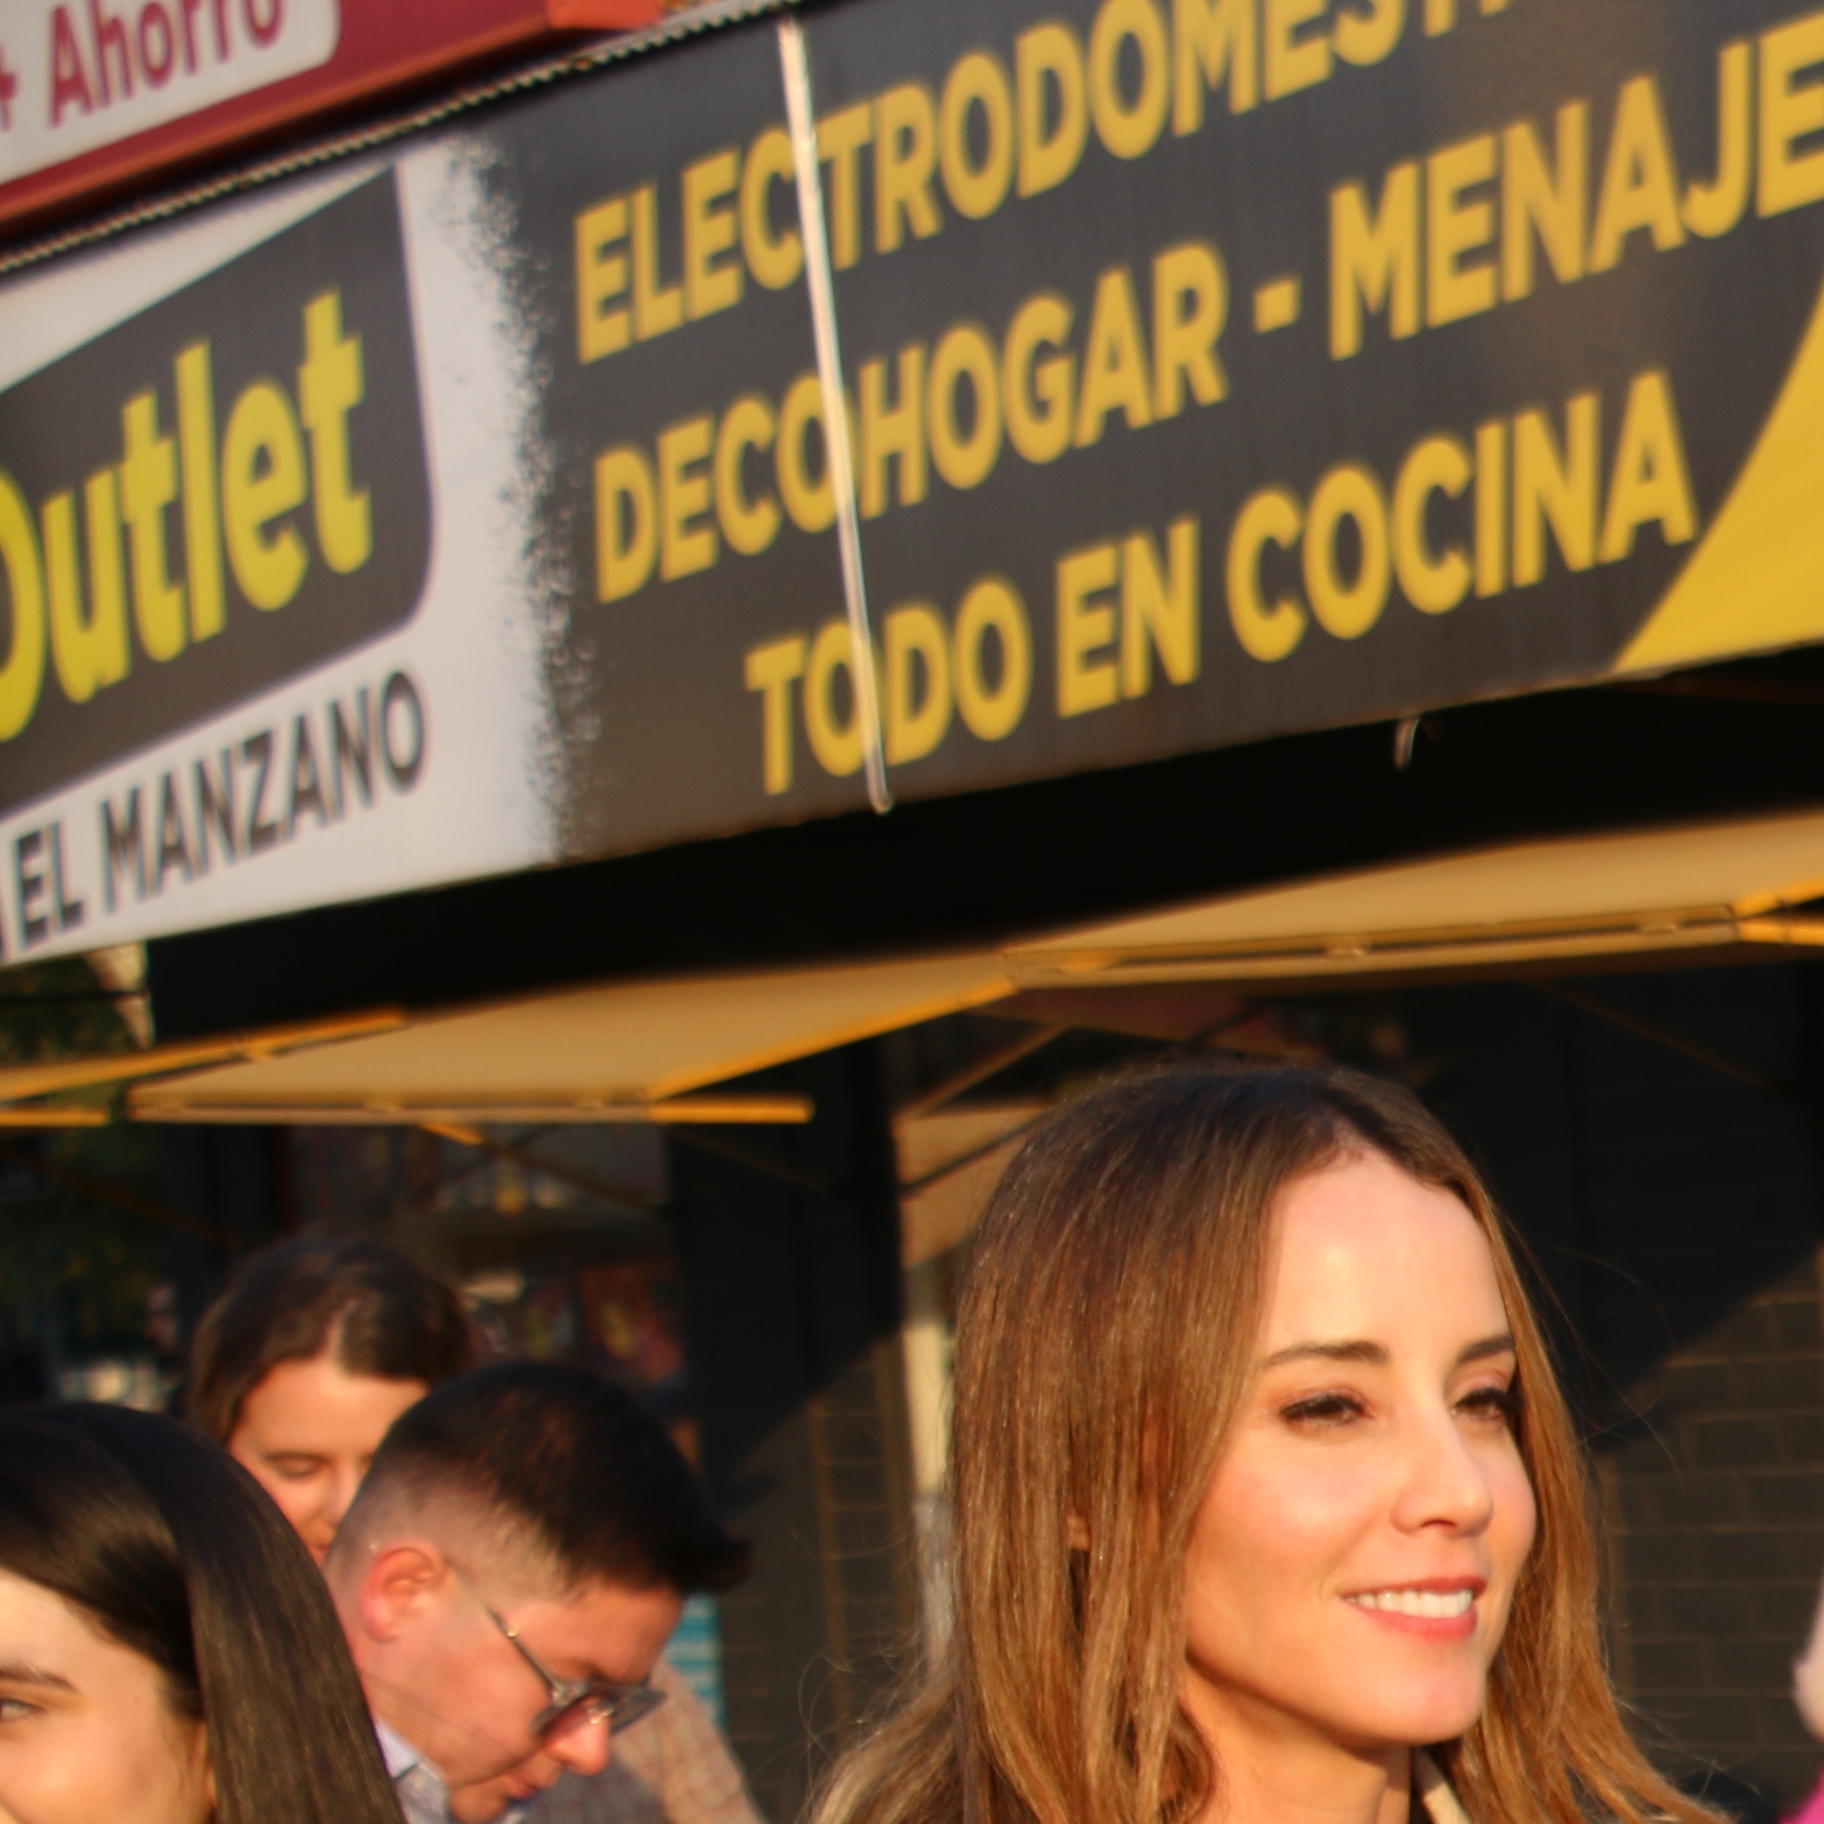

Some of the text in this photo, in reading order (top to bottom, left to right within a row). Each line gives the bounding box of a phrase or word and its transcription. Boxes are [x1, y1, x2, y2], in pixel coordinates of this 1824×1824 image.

[49, 0, 285, 128] Ahorro
[594, 242, 1227, 602] DECOHOGAR
[746, 371, 1697, 794] TODO EN COCINA
[14, 671, 424, 950] EL MANZANO
